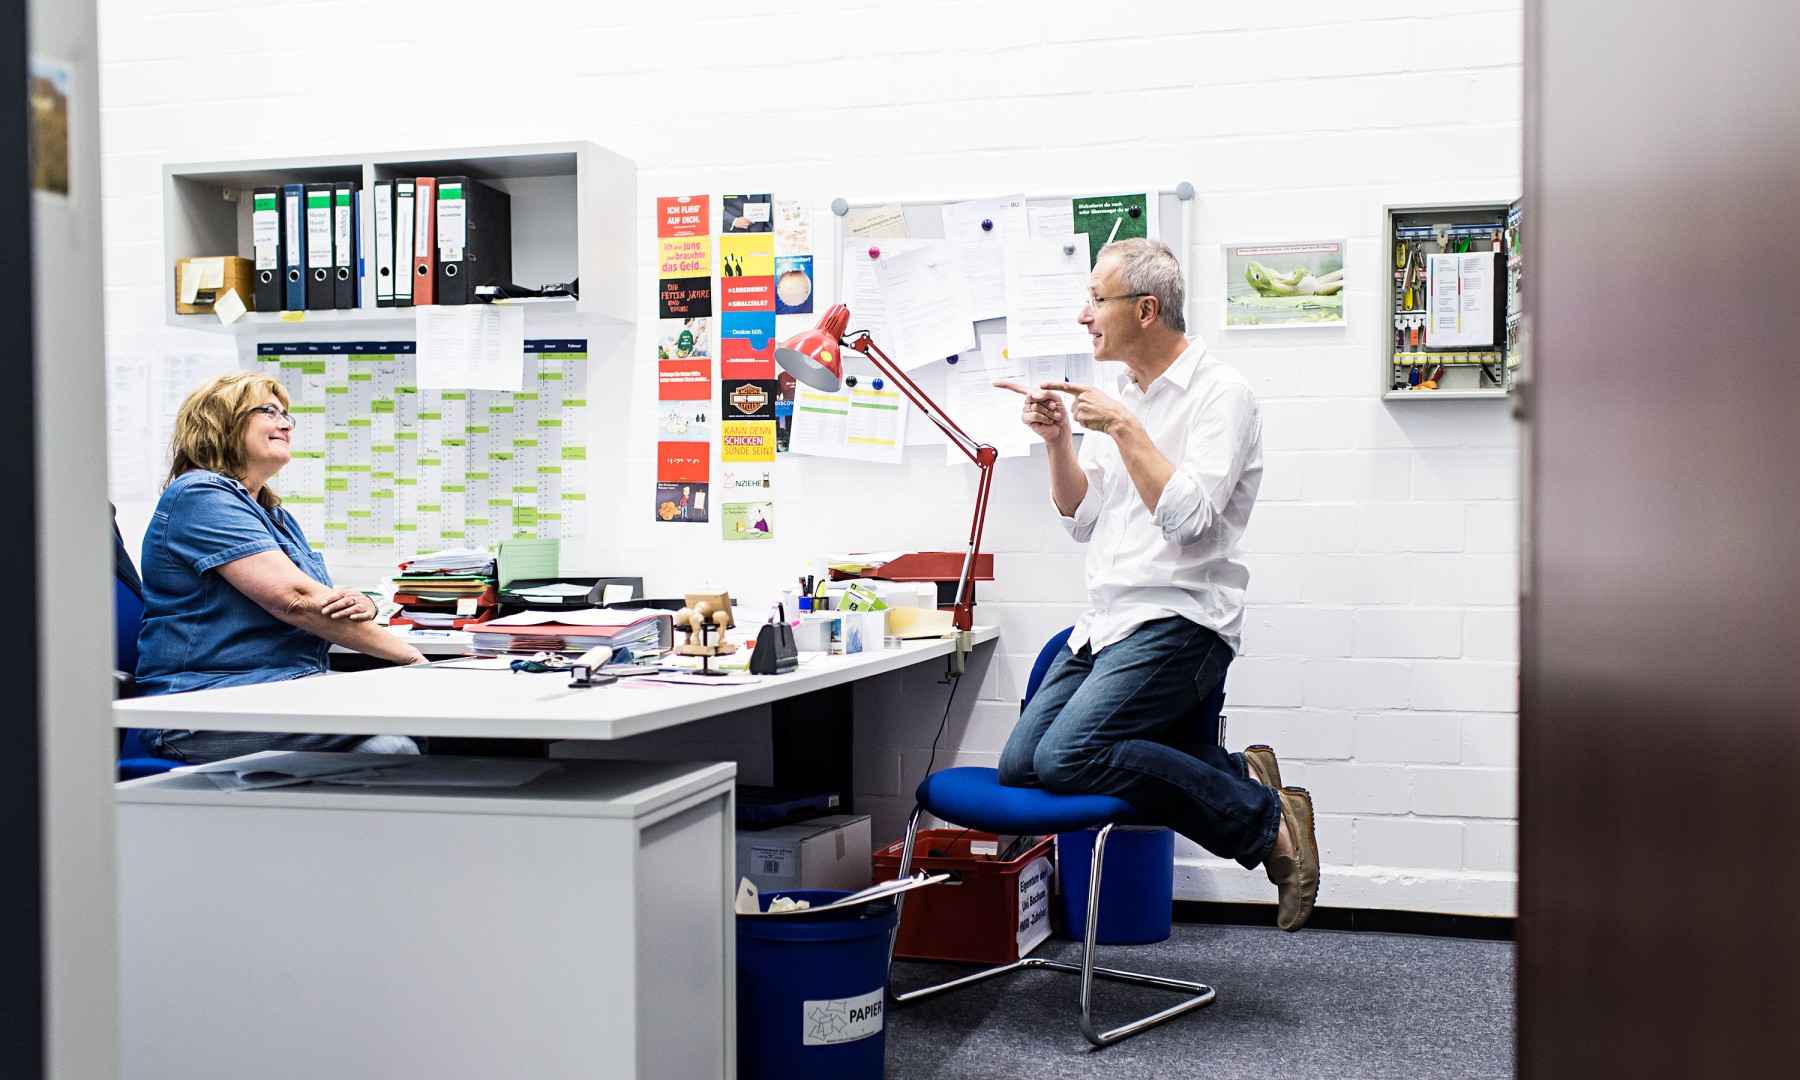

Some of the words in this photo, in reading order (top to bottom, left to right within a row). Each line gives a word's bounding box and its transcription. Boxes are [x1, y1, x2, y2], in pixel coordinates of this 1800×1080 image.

[667, 206, 680, 214] ICH
[340, 210, 348, 239] Doppik
[667, 216, 681, 225] AUF
[682, 216, 701, 224] DICH.
[683, 241, 701, 251] jung
[675, 251, 706, 260] brauchte
[662, 262, 678, 272] das
[661, 290, 685, 300] FETTEN
[686, 289, 710, 302] JAHRE
[724, 427, 747, 435] KANN
[750, 426, 771, 434] DENN
[724, 436, 763, 445] SCHICKEN
[752, 446, 774, 455] SEIN?
[1020, 874, 1039, 893] Eigentum
[1022, 899, 1030, 912] Uni
[1029, 889, 1046, 908] Bochum
[849, 1000, 882, 1023] PAPIER
